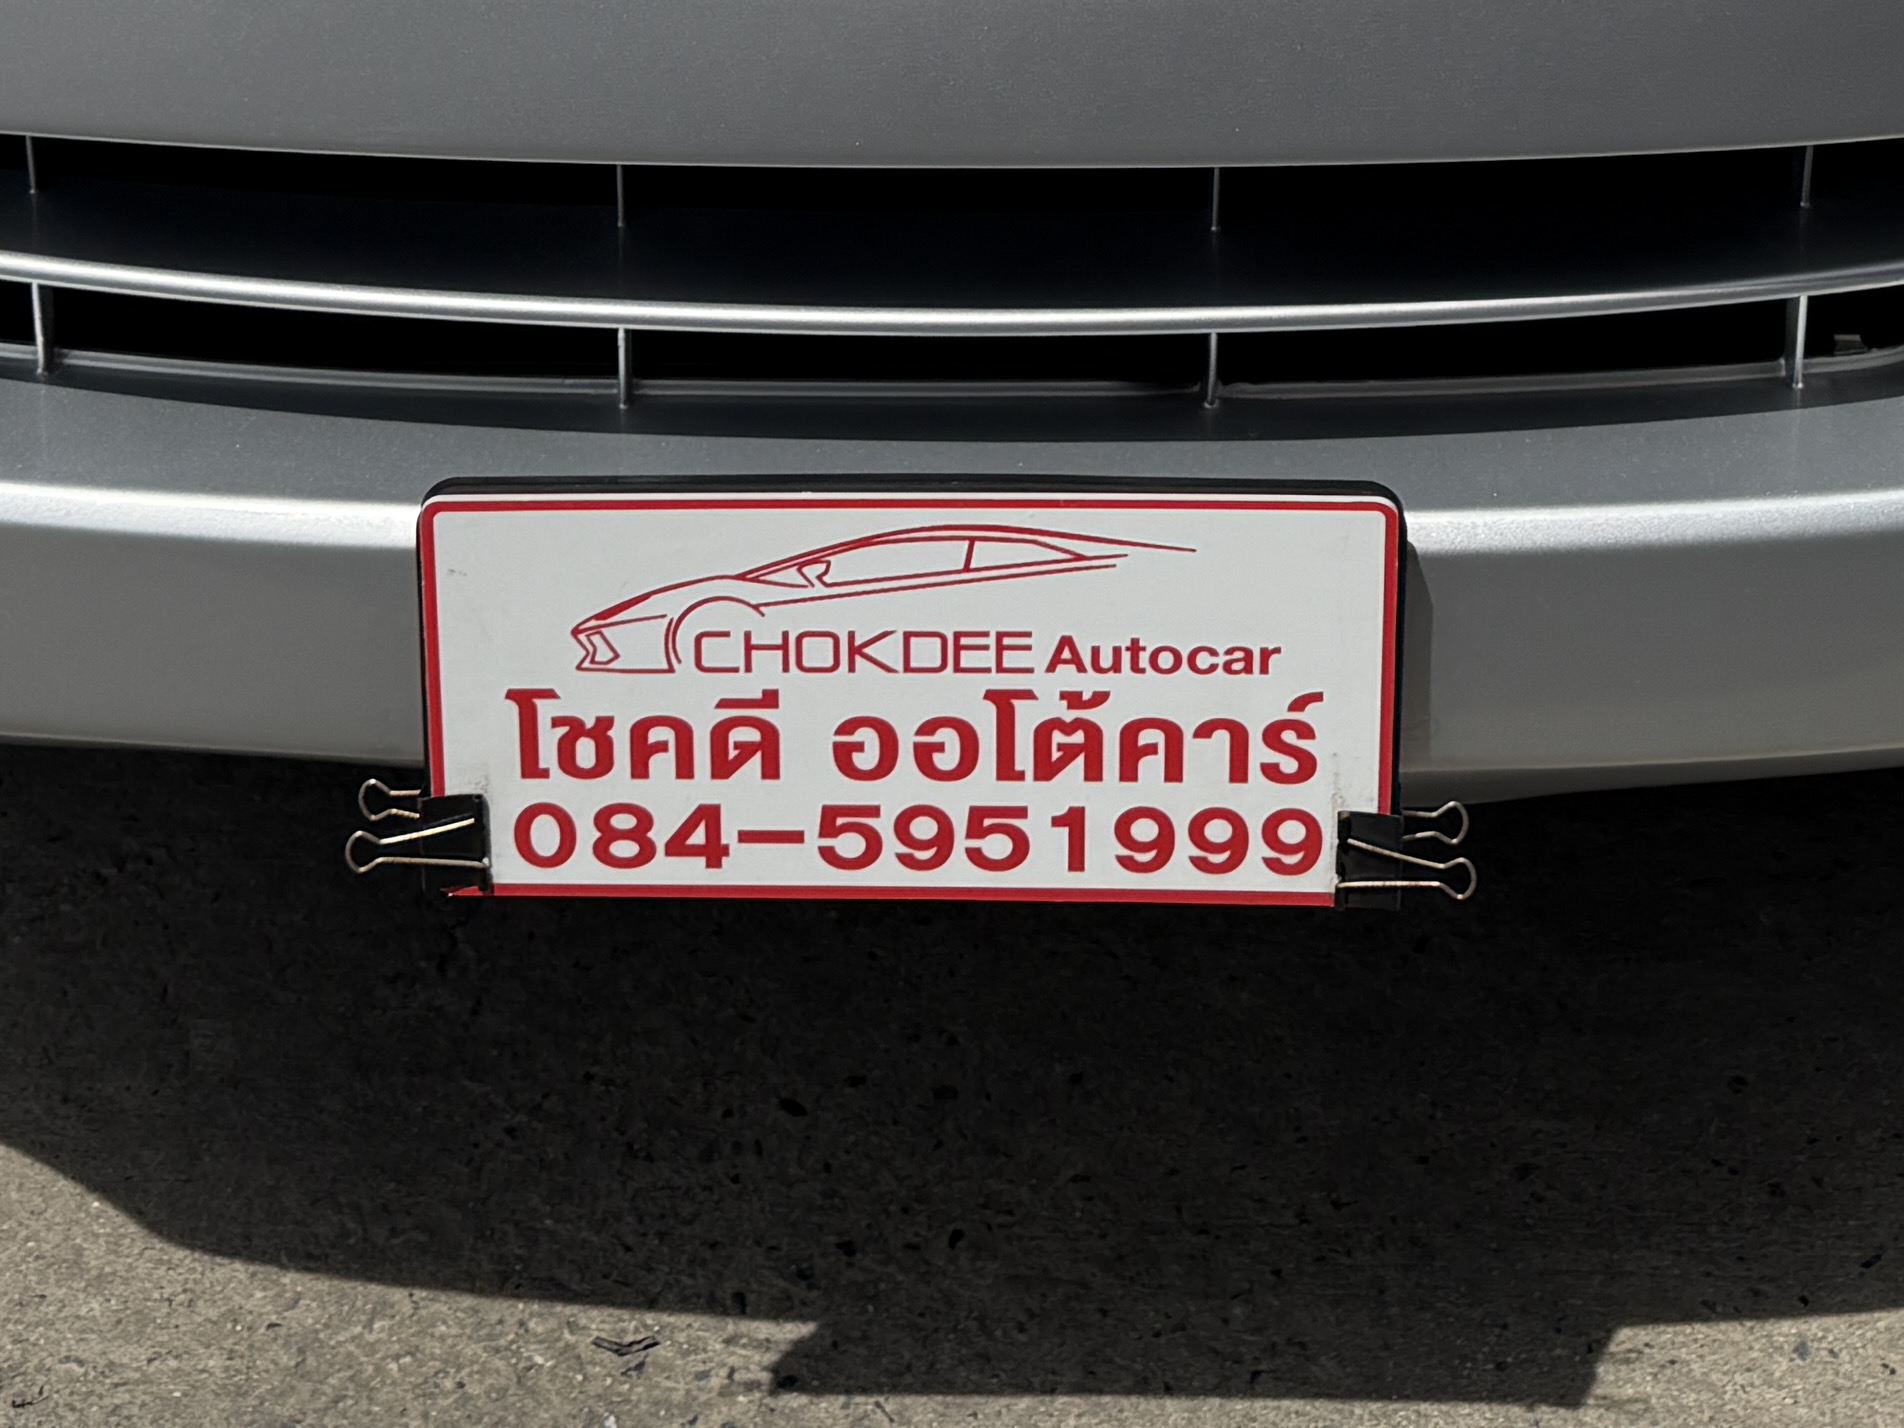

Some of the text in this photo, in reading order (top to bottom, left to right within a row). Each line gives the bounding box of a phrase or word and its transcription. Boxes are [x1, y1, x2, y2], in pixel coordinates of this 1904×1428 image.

[694, 630, 1281, 676] CHOKDEE Autocar
[505, 688, 1325, 786] โชคดี ออโต้คาร์
[513, 802, 1324, 877] 084-5951999
